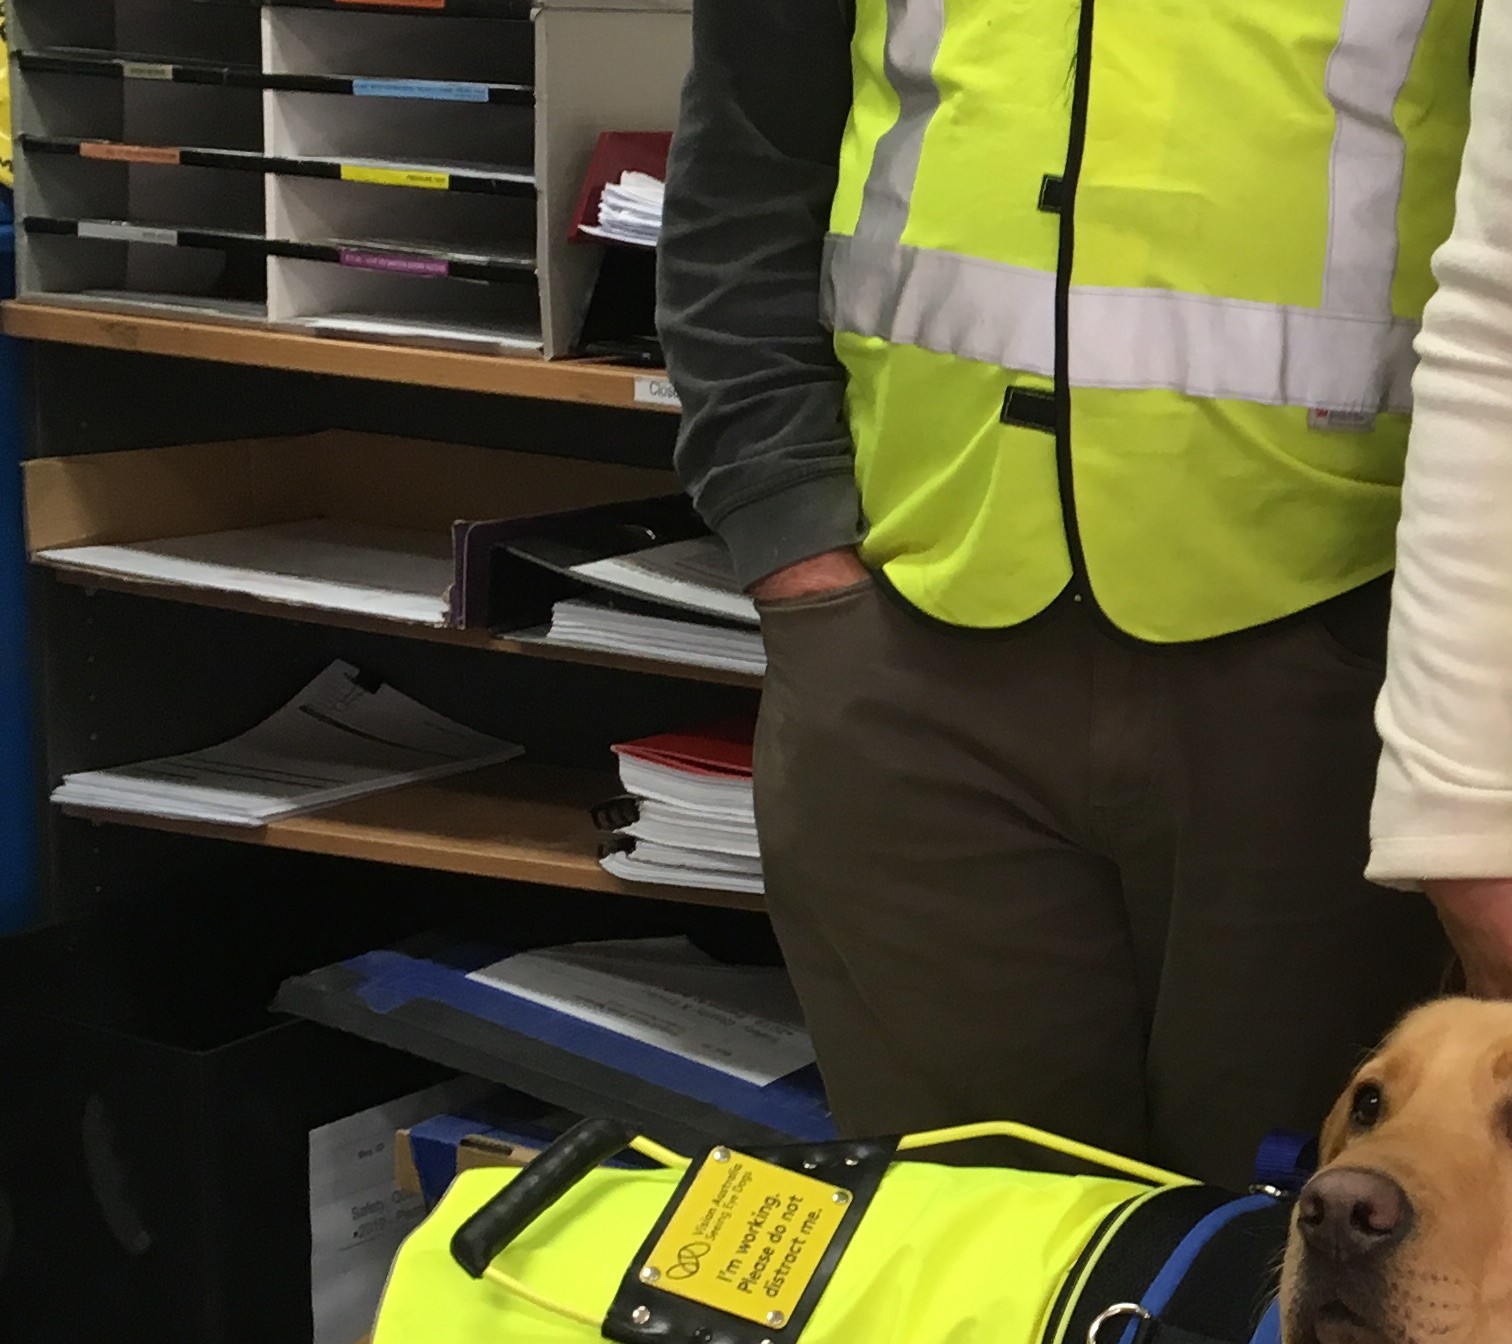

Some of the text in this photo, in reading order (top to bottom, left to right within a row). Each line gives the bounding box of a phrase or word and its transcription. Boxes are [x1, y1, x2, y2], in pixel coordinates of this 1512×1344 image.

[692, 1162, 743, 1237] Vision Australia
[705, 1209, 733, 1242] Seeing
[716, 1192, 781, 1283] I'm working.
[737, 1193, 804, 1295] Please do not
[763, 1208, 823, 1298] distract me.
